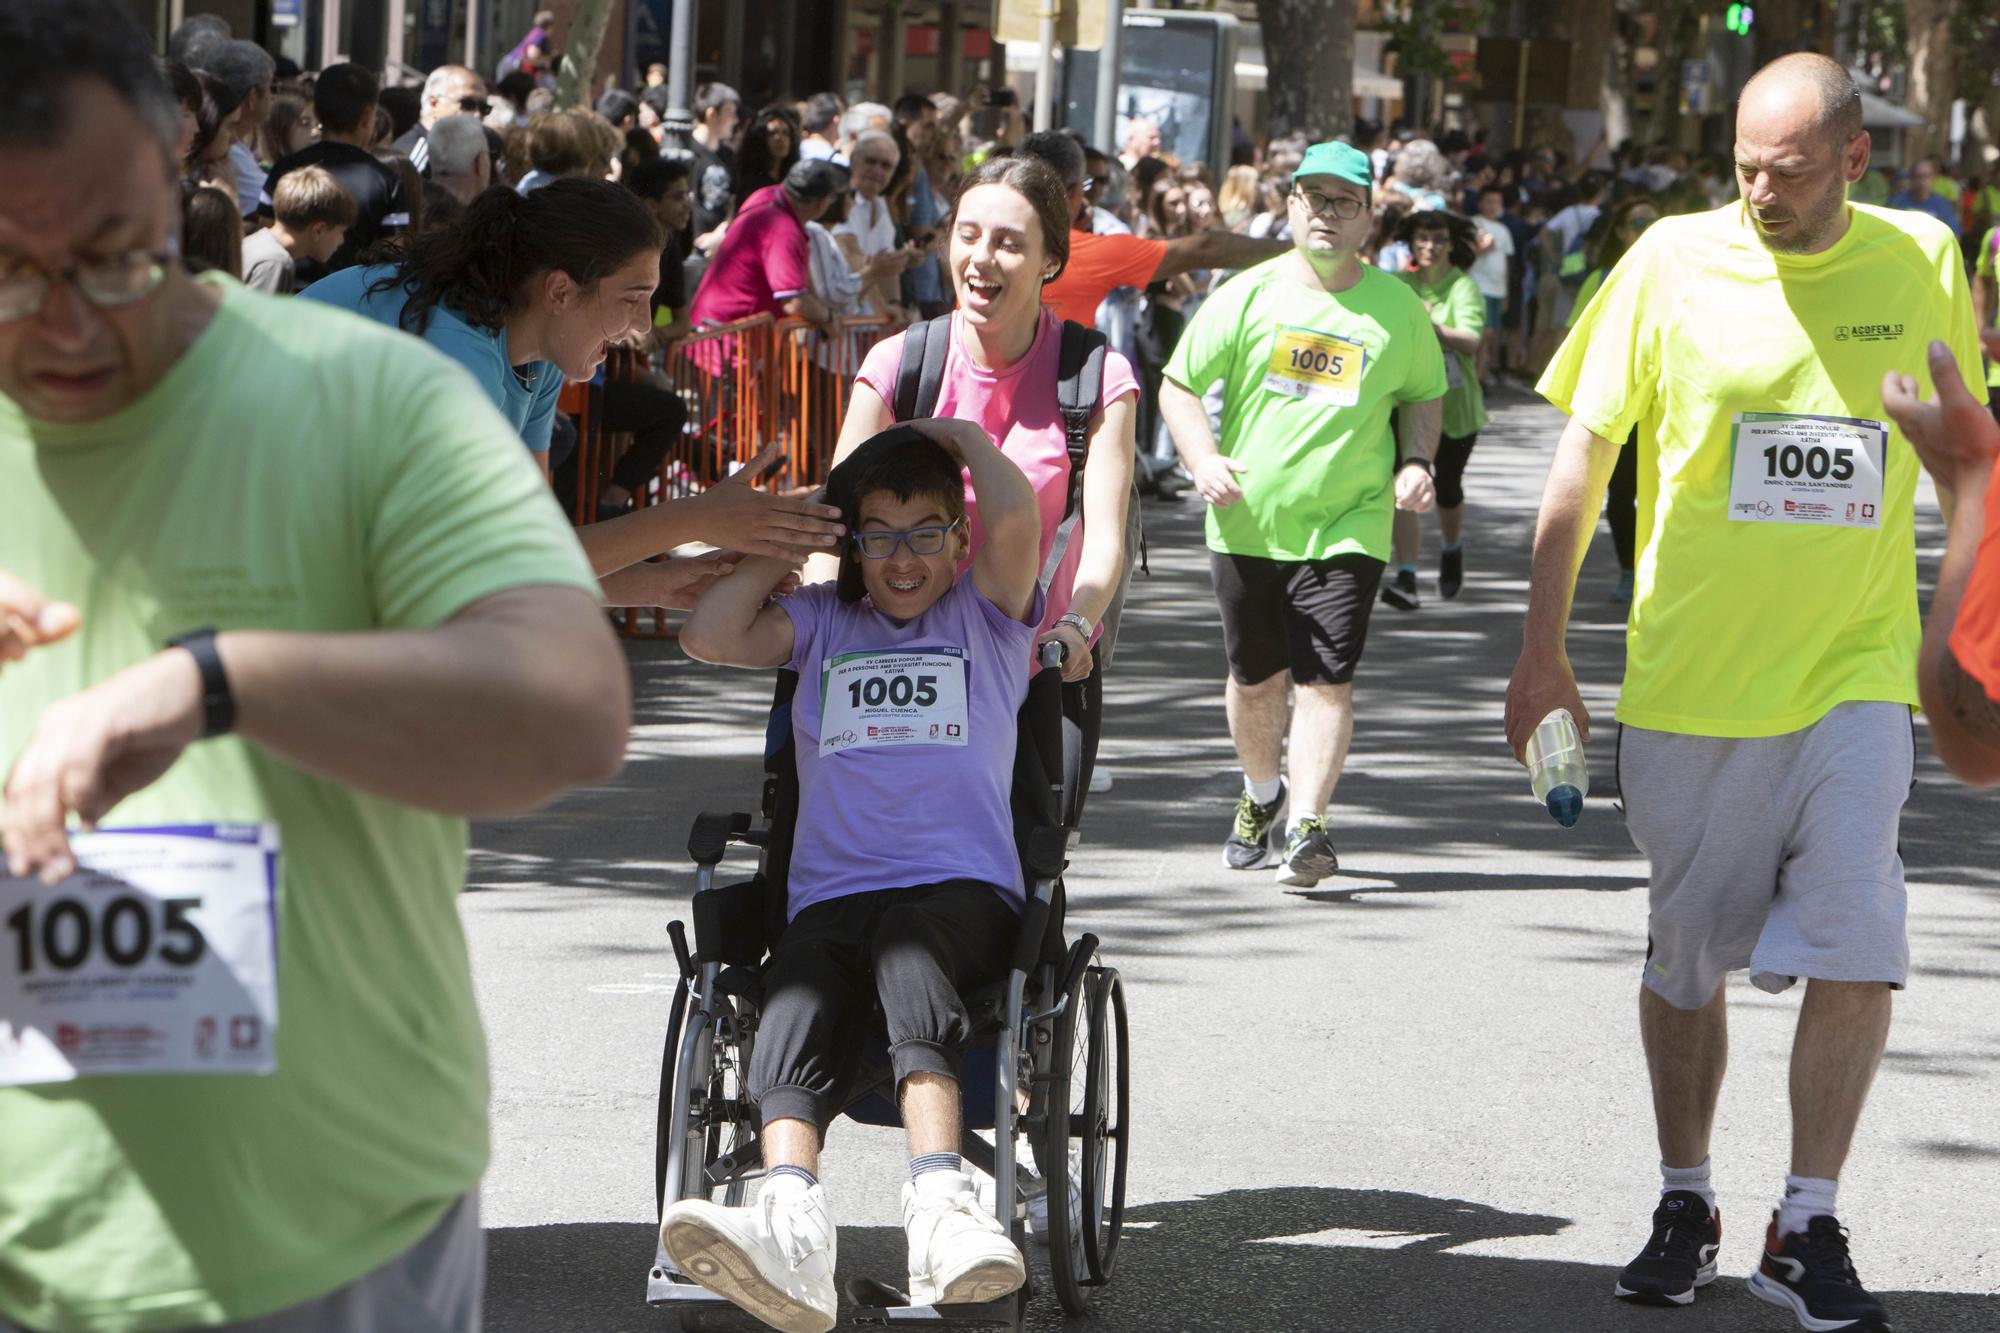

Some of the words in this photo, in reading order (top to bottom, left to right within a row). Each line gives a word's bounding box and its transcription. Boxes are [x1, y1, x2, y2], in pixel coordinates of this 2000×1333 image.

[1291, 348, 1344, 376] 1005
[1763, 444, 1855, 481] 1005
[1763, 479, 1784, 487] ENRIC
[1808, 481, 1854, 489] SANTANDREU
[848, 674, 938, 709] 1005
[8, 896, 207, 975] 1005
